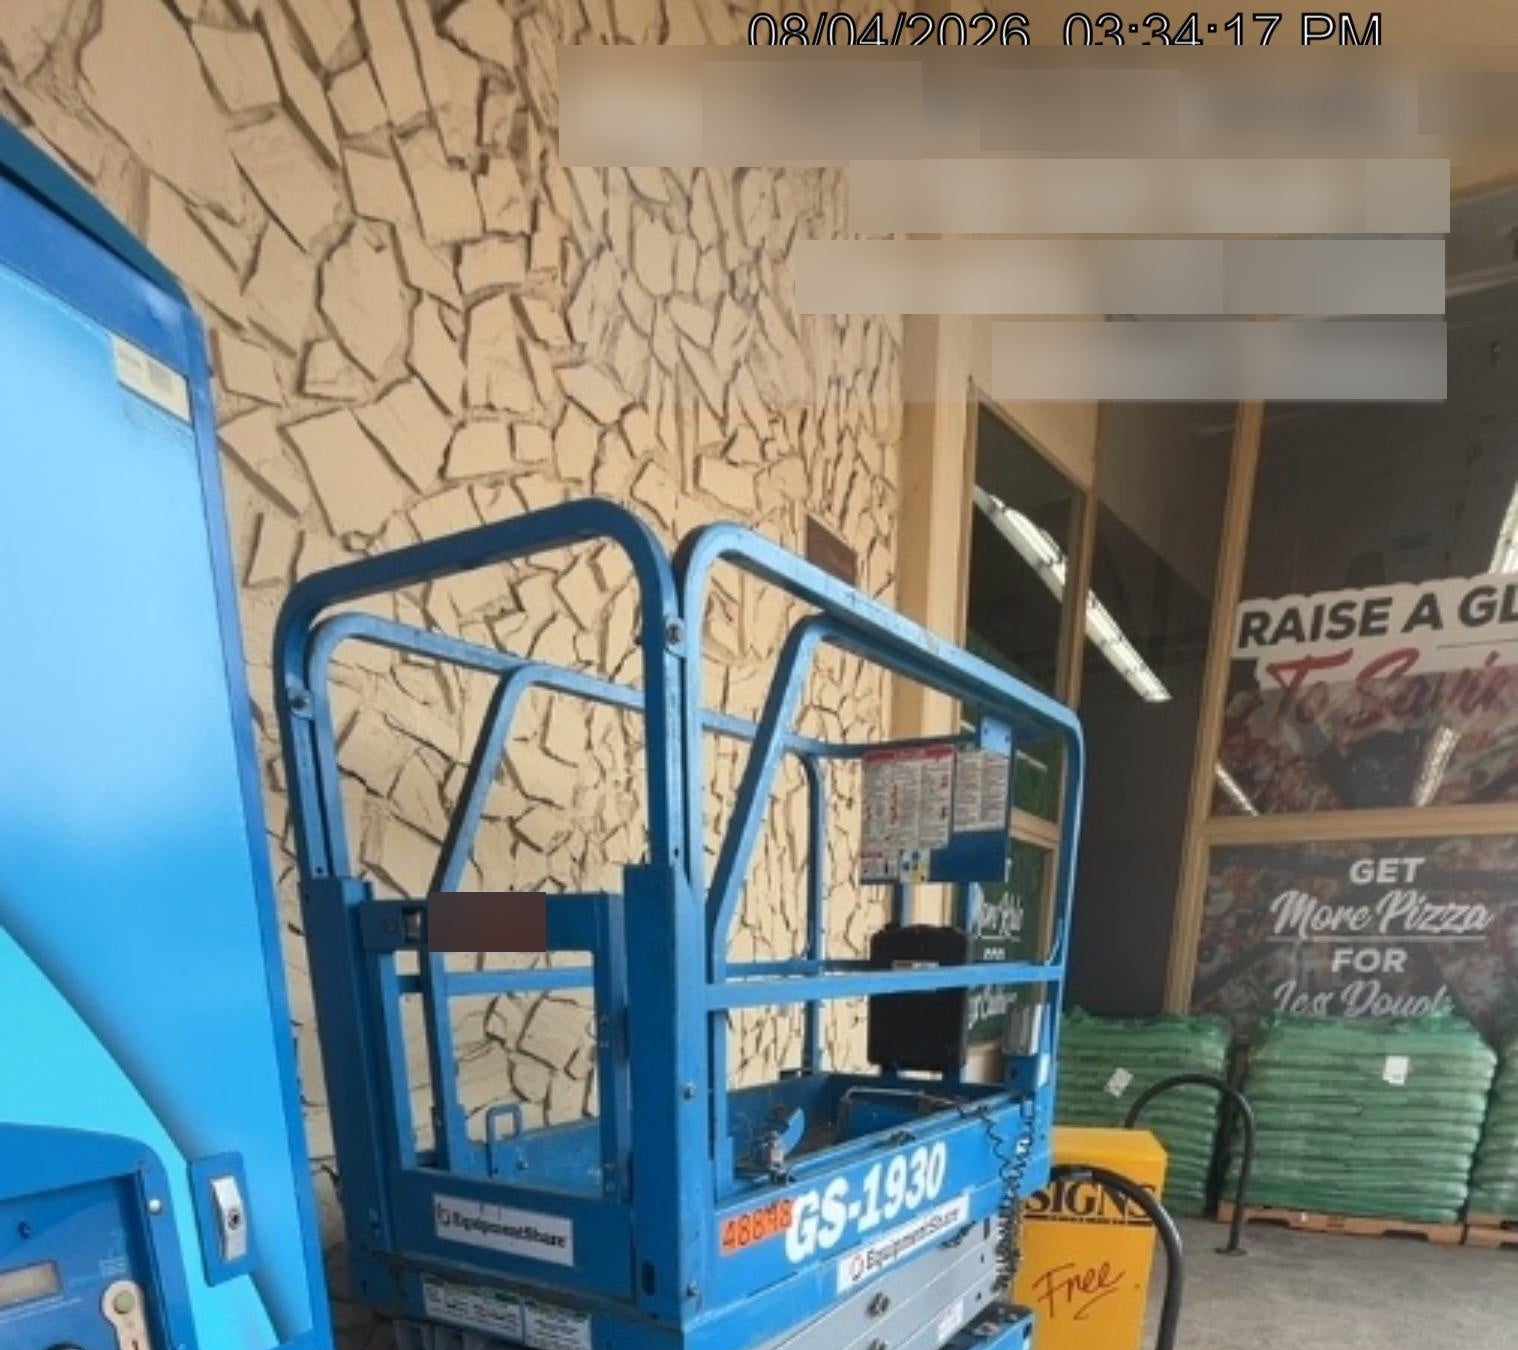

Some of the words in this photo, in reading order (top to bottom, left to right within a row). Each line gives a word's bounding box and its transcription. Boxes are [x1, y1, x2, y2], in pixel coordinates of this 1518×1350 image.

[1238, 597, 1393, 648] RAISE
[1401, 593, 1444, 633] A
[1350, 857, 1426, 885] GET
[1270, 889, 1374, 940] More
[1376, 889, 1496, 935] Pizza
[1331, 948, 1409, 974] FOR
[785, 1141, 947, 1264] GS-1930
[866, 1207, 960, 1271] EquipmentShare
[1032, 1262, 1126, 1318] Free
